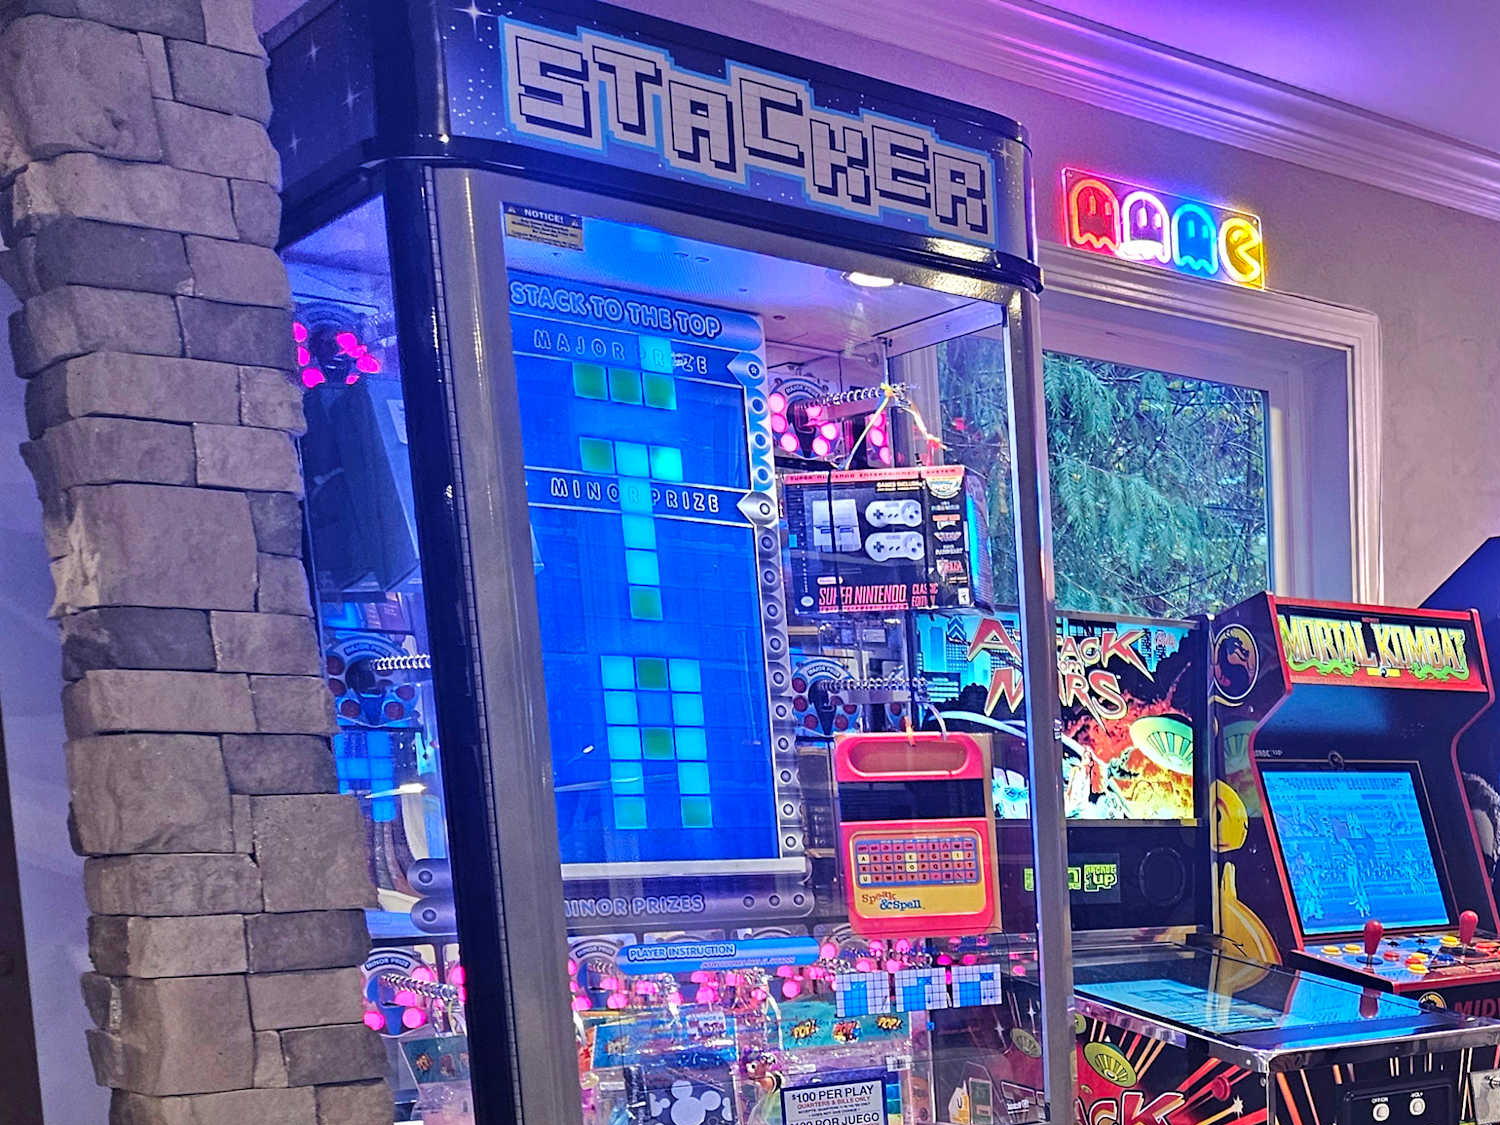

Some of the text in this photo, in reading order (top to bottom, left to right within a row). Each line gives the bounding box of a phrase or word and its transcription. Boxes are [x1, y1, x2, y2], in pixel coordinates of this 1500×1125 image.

[508, 28, 992, 236] STACKER
[524, 208, 565, 223] NOTICE!
[510, 281, 722, 338] STACK TO THE TOP
[533, 328, 625, 361] MAJOR
[551, 477, 719, 513] MINOR PRIZE
[855, 584, 907, 605] NINTENDO
[1277, 614, 1466, 672] MORTAL KOMBAT
[984, 667, 1129, 738] MRS
[634, 894, 705, 916] PRIZES
[861, 891, 897, 905] Speak
[628, 944, 736, 961] PLAYER INSTRUCTION
[792, 1084, 874, 1103] $100 PER PLAY
[841, 1112, 880, 1125] JUEGO
